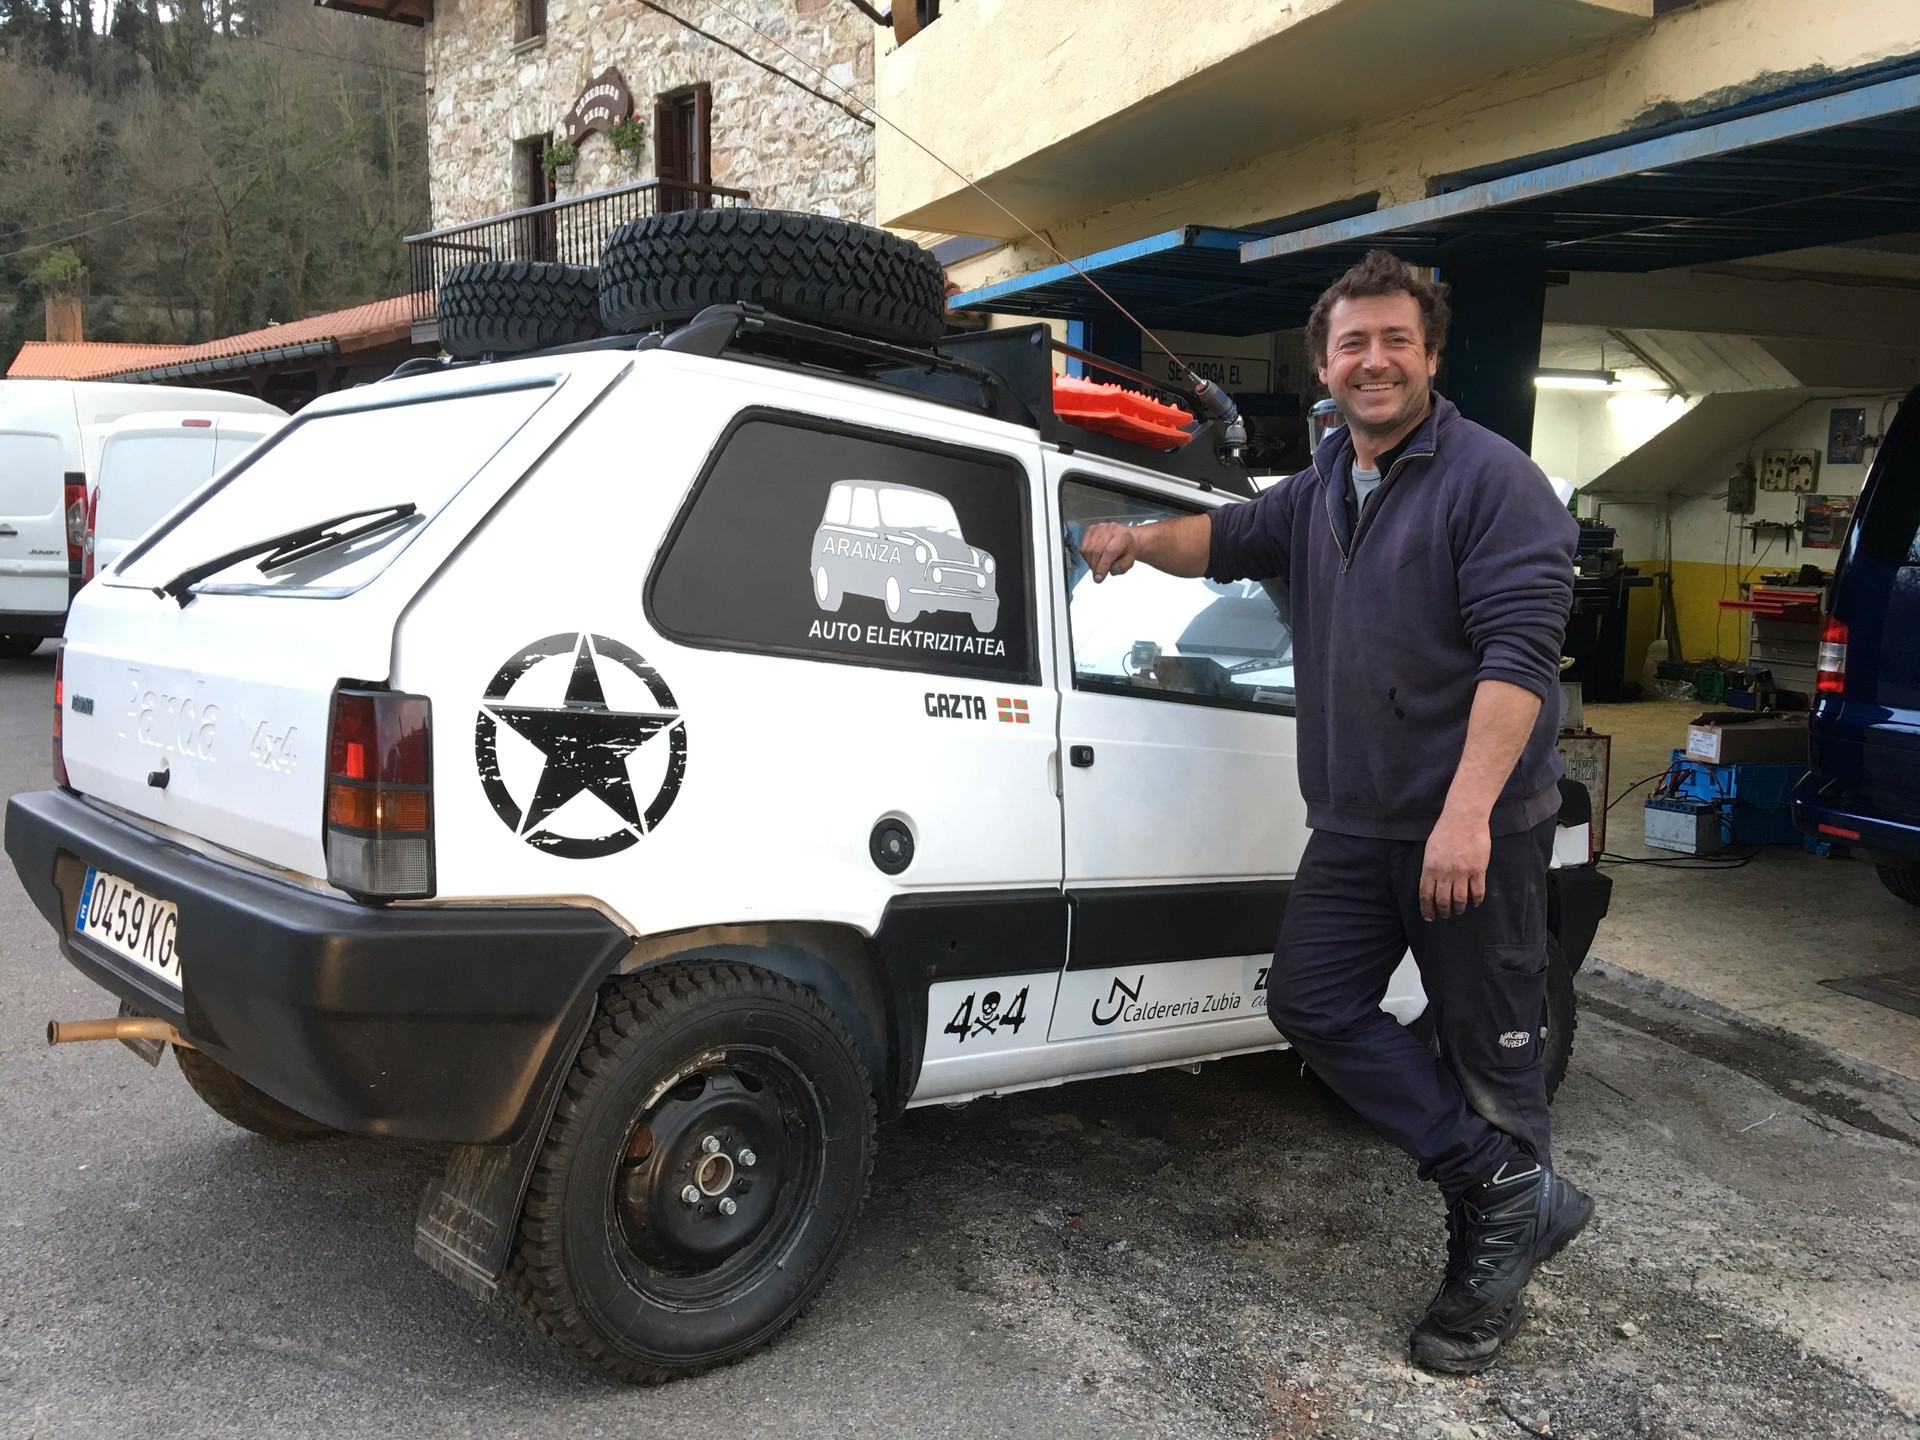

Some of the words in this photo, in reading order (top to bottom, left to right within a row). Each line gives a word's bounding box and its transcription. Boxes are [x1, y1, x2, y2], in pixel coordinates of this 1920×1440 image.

[1168, 360, 1183, 381] SE
[1229, 364, 1242, 385] EL
[822, 536, 902, 565] ARANZA
[808, 619, 862, 642] AUTO
[866, 625, 1006, 657] ELEKTRIZITATEA
[118, 667, 221, 763] Panda
[249, 720, 299, 775] 4x4
[924, 692, 987, 720] GAZTA
[1123, 997, 1200, 1023] Caldereria
[1201, 991, 1242, 1013] Zubia
